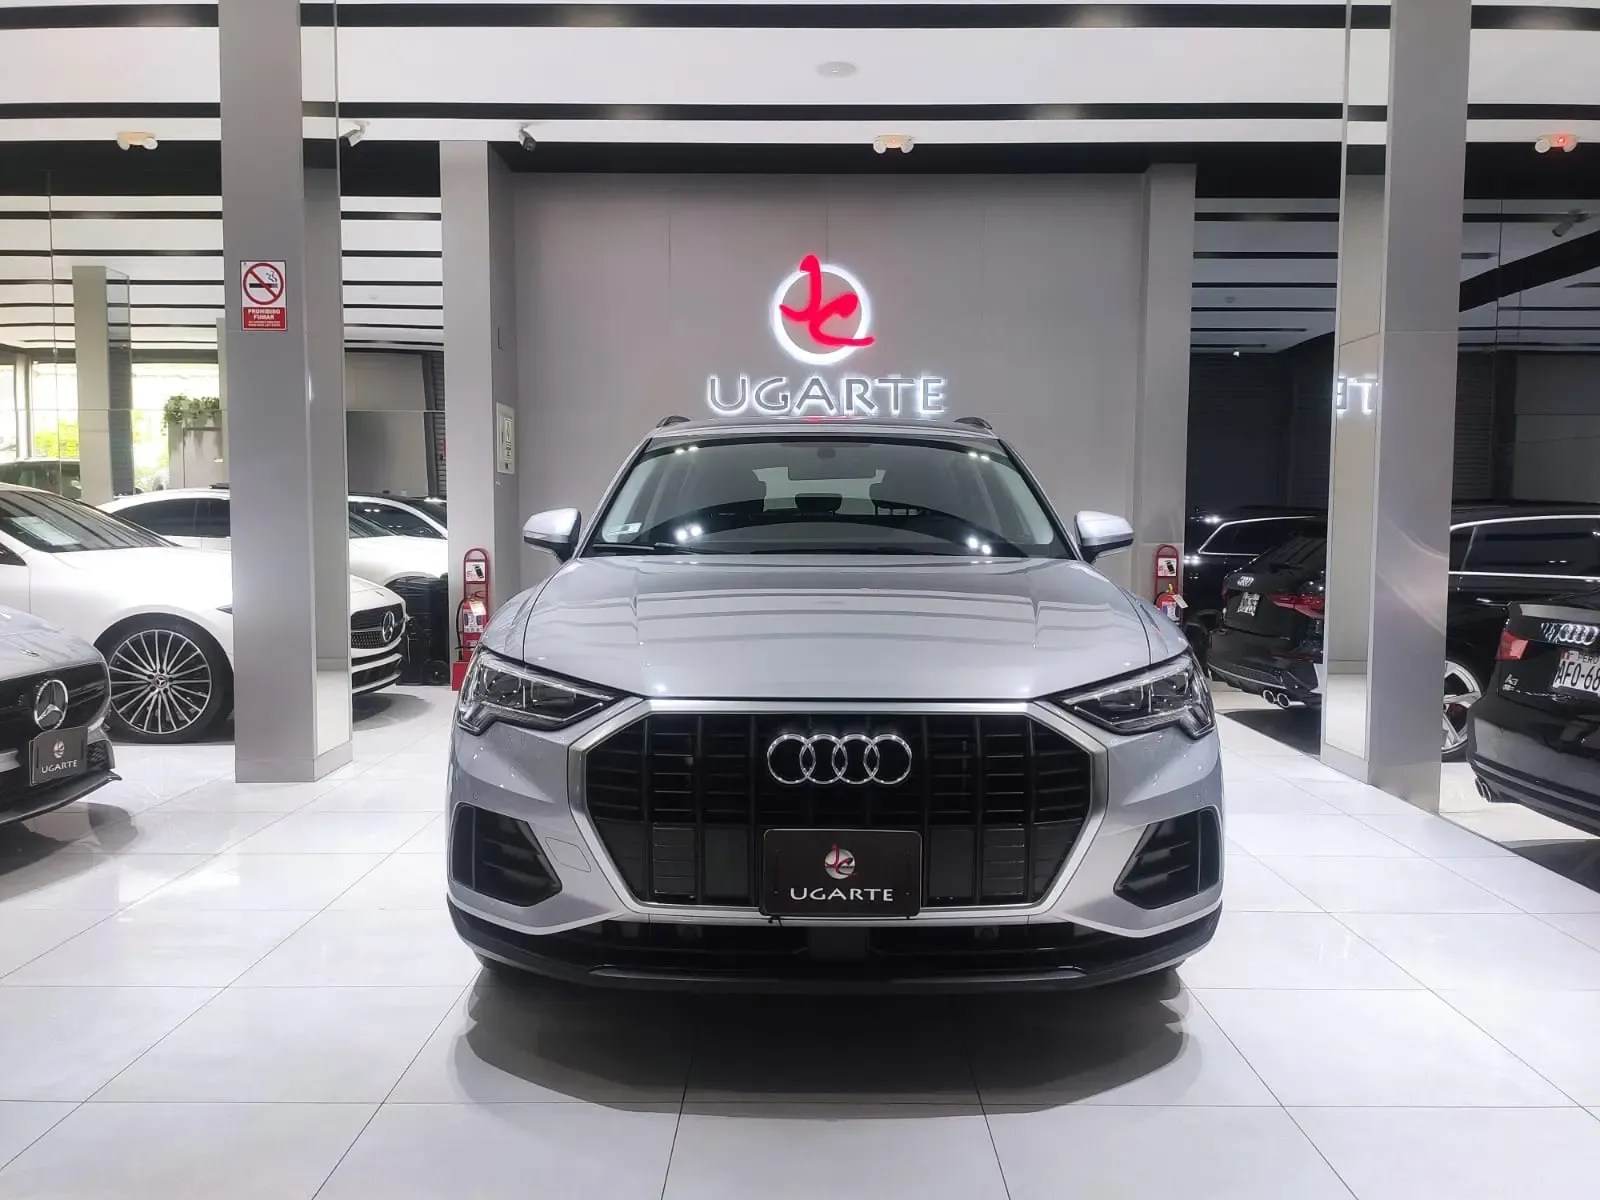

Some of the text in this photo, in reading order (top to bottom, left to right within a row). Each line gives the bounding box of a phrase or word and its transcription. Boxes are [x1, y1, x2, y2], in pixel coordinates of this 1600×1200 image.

[709, 375, 946, 413] UGARTE
[41, 760, 78, 774] UGARTE
[790, 888, 894, 902] UGARTE
